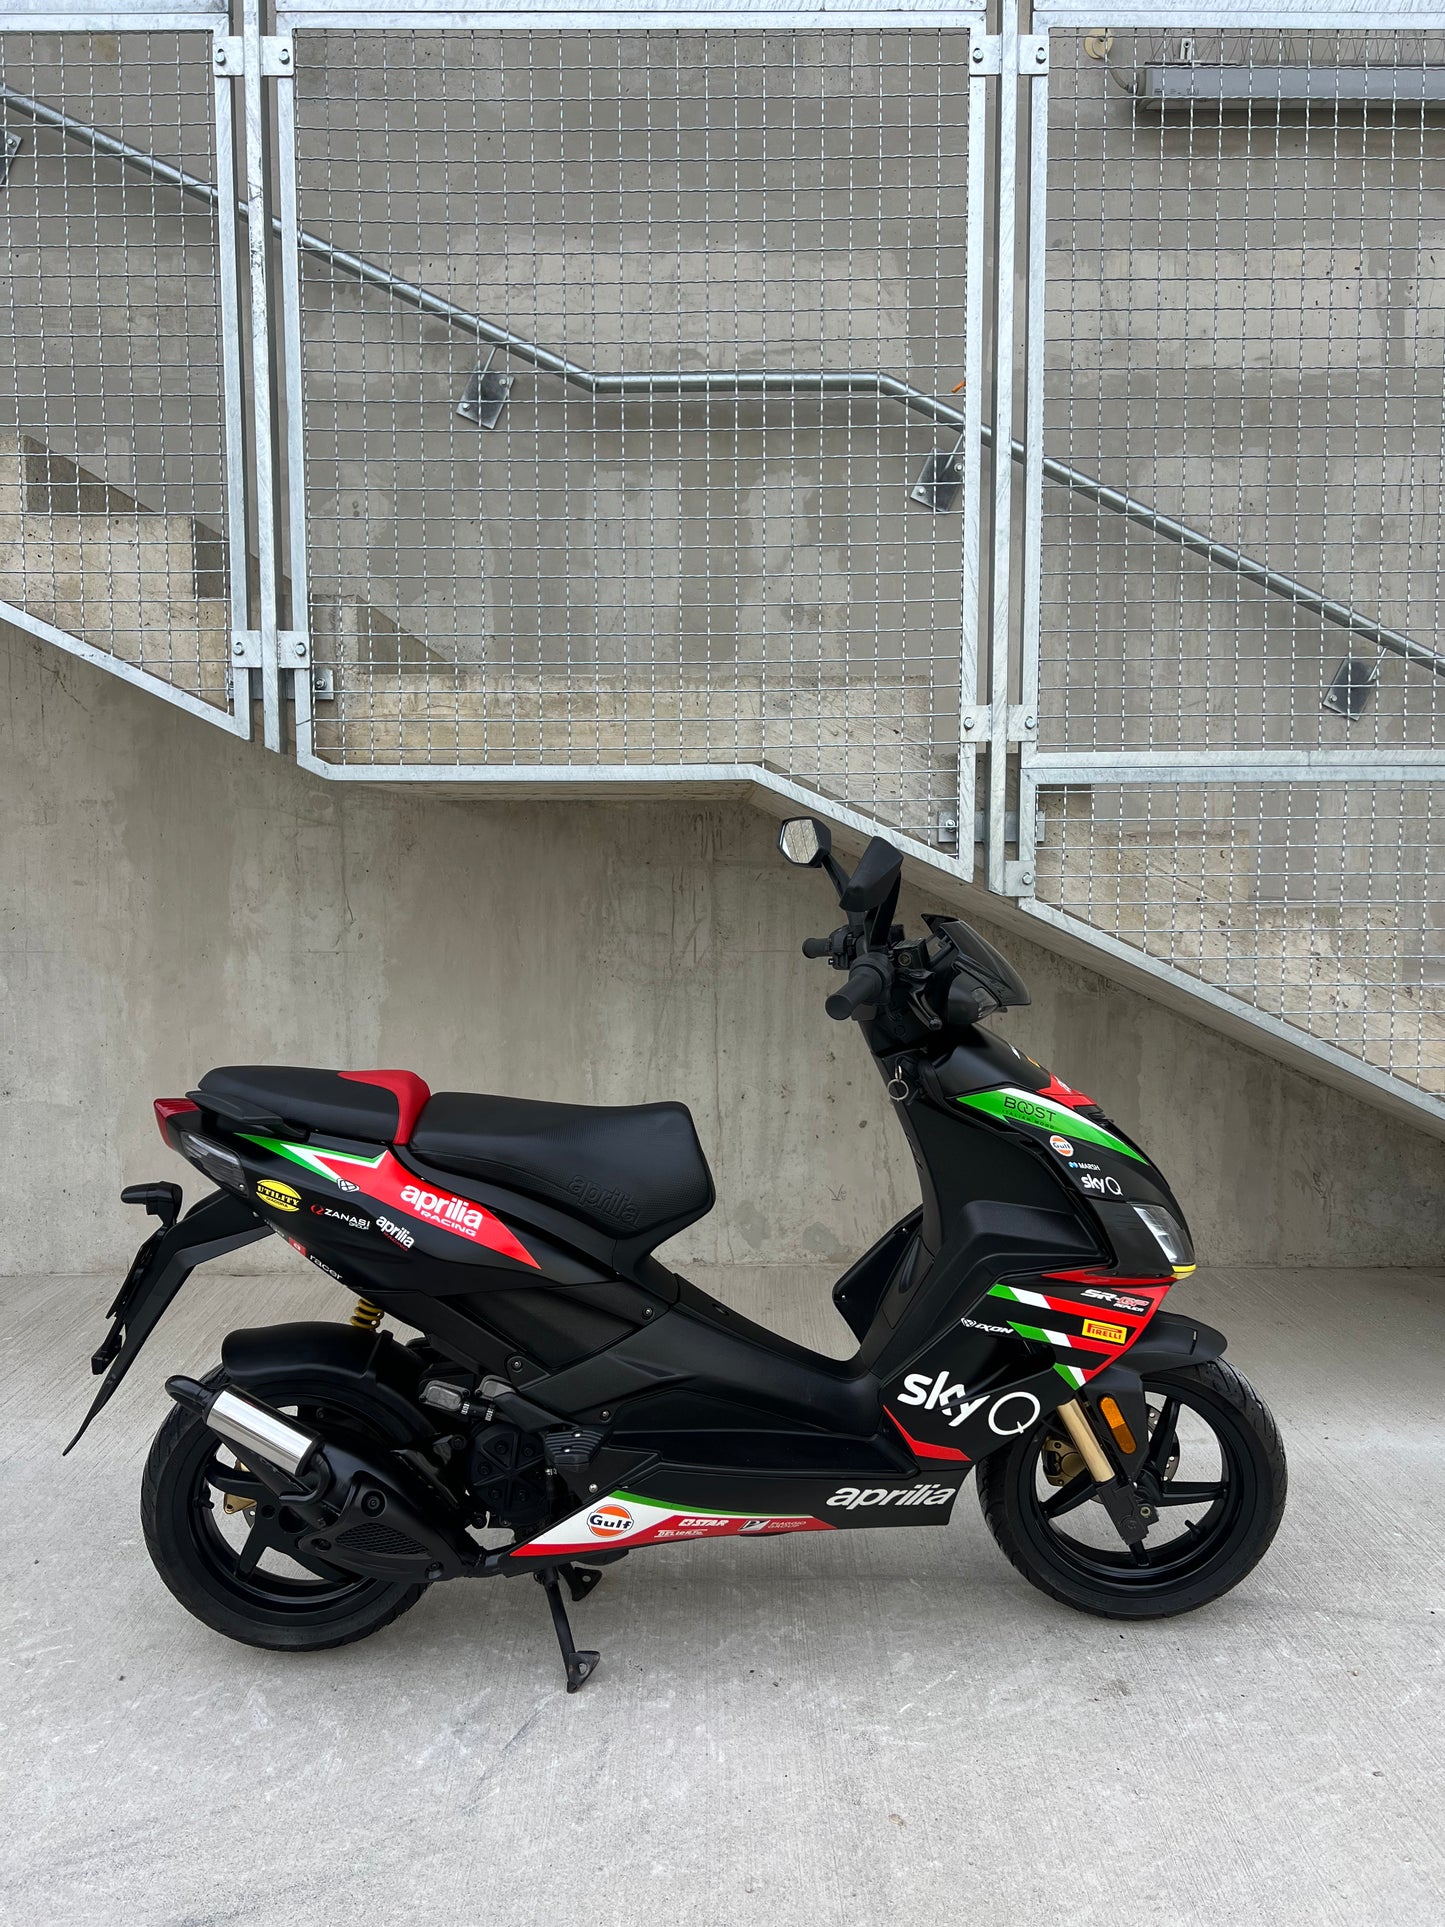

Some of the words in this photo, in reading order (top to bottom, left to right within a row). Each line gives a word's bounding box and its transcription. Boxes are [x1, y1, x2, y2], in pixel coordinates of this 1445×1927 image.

[1004, 1096, 1056, 1121] BOOST
[1077, 1162, 1101, 1171] MARSH
[257, 1185, 300, 1206] UTILITY
[1081, 1174, 1105, 1193] sky
[1105, 1176, 1123, 1196] Q
[400, 1185, 483, 1230] aprilia
[568, 1175, 640, 1226] aprilia
[324, 1208, 371, 1227] ZANASI
[420, 1210, 477, 1238] RACING
[376, 1216, 415, 1249] aprilia
[309, 1254, 343, 1280] racer
[974, 1323, 1015, 1335] IXON
[1086, 1323, 1123, 1340] PIRELLI
[897, 1371, 991, 1427] sky
[988, 1391, 1041, 1436] Q
[826, 1484, 956, 1510] aprilia
[590, 1515, 631, 1529] Gulf
